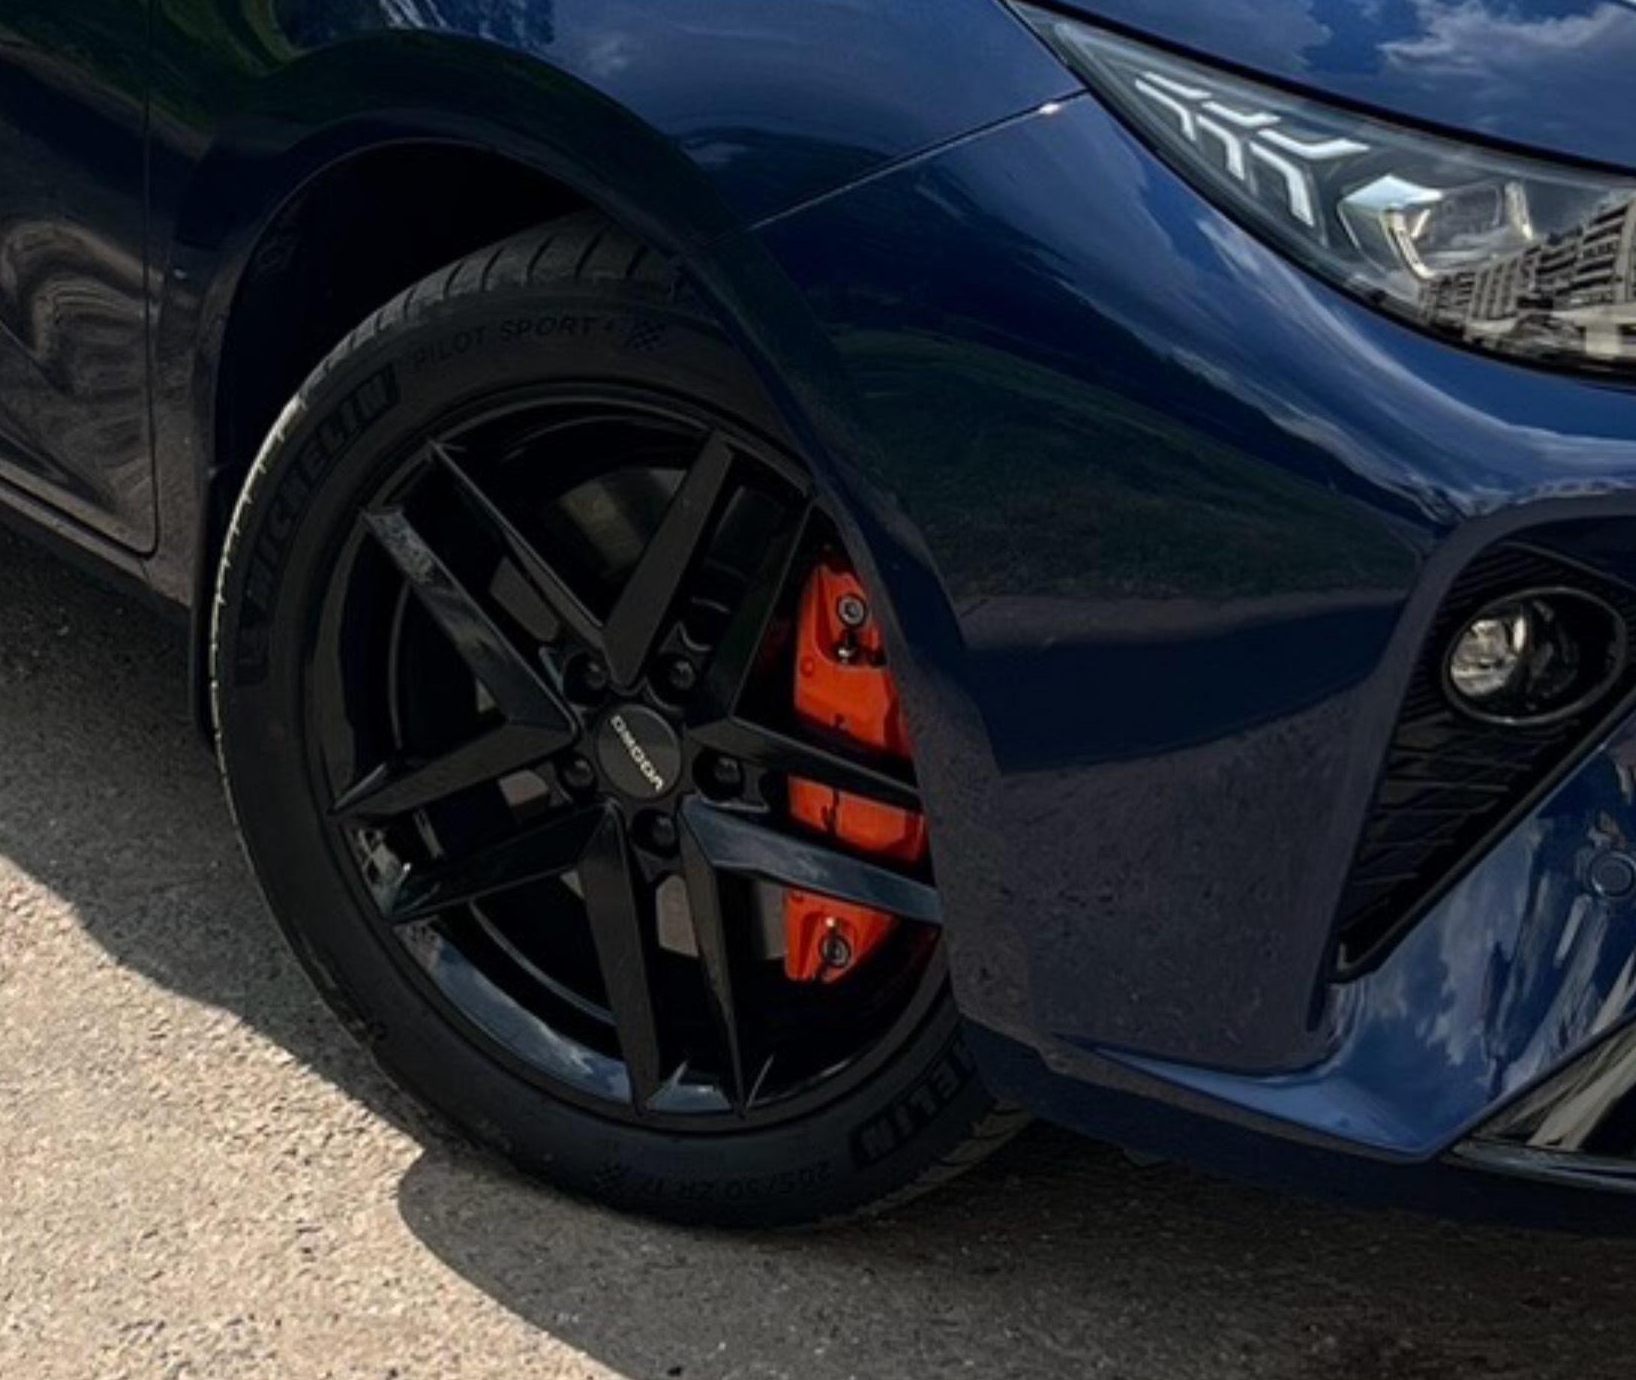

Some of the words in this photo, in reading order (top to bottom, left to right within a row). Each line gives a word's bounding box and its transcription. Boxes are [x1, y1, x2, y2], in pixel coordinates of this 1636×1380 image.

[411, 324, 486, 372] PILOT
[498, 314, 598, 342] SPORT
[244, 368, 394, 613] MICHELIN
